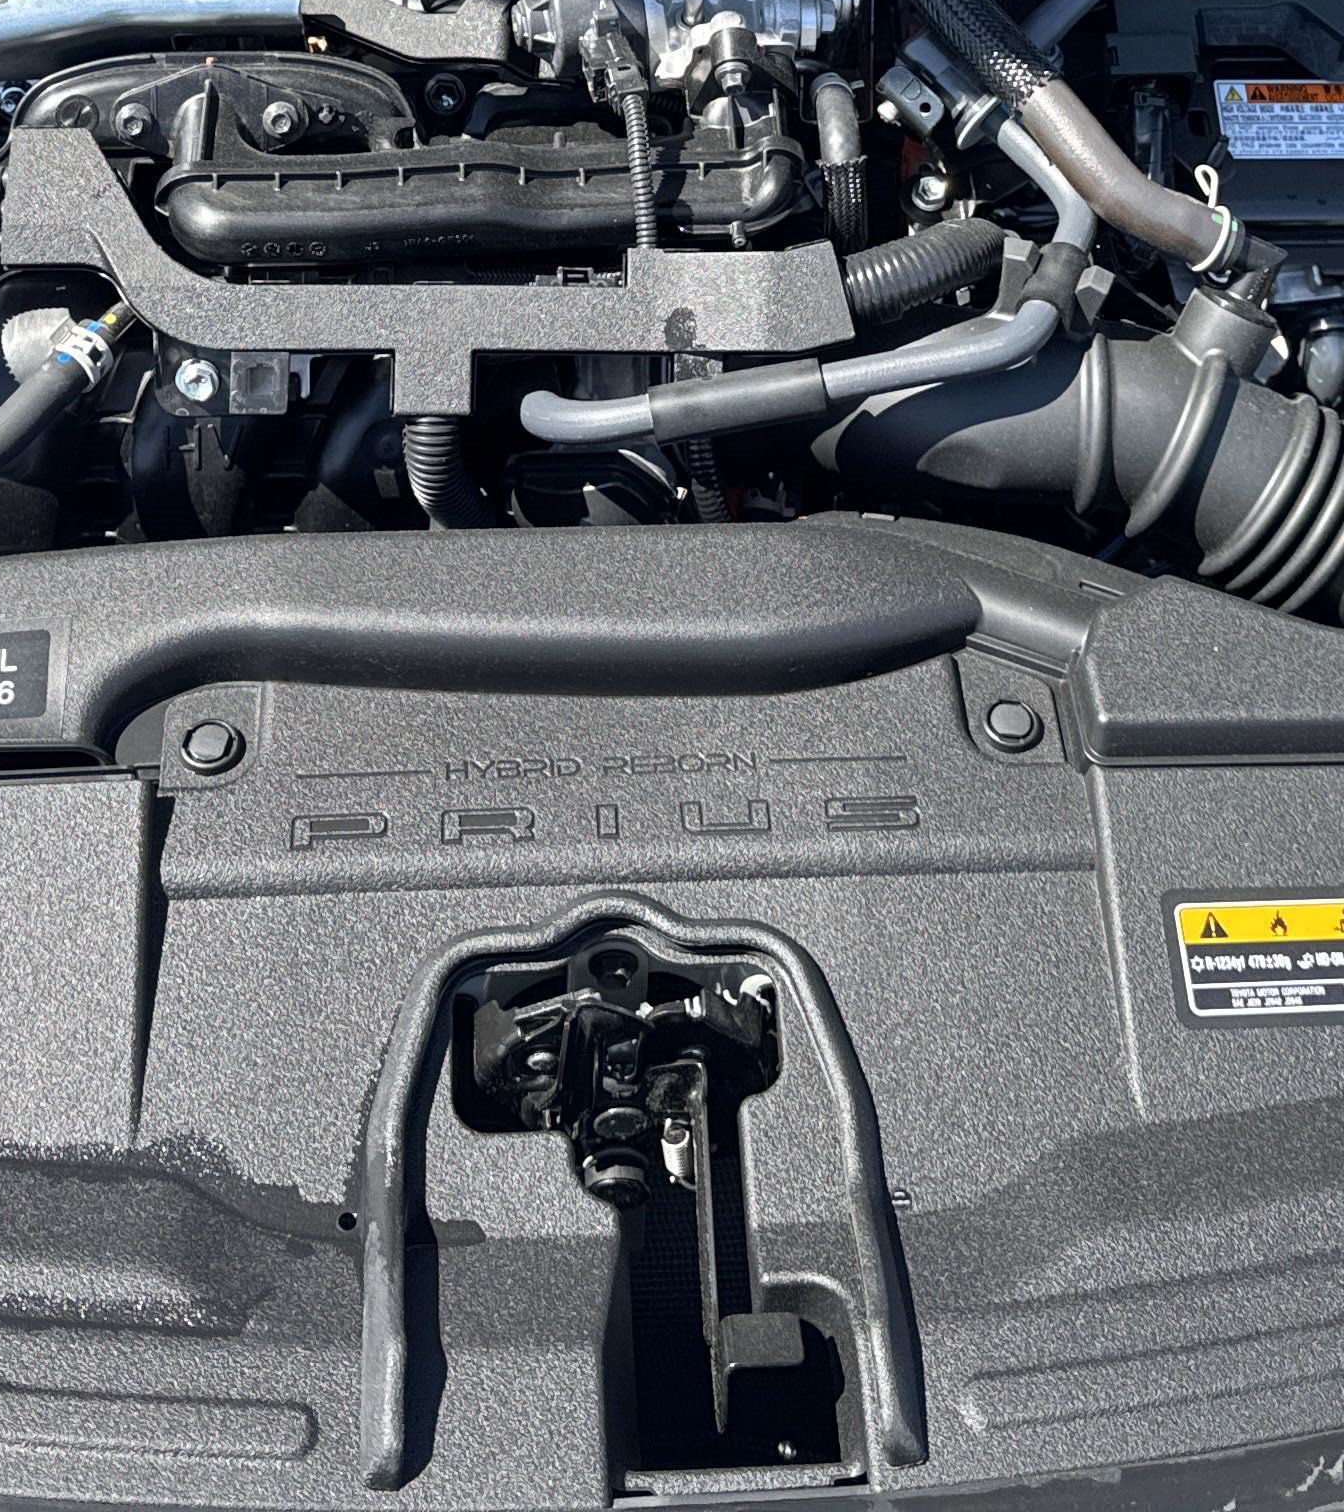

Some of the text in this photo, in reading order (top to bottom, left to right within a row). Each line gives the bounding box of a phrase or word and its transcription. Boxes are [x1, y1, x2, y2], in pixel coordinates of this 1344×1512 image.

[445, 751, 758, 781] HYBRID REBORN
[290, 796, 920, 850] PRIUS
[1230, 986, 1326, 998] TOYOTA MOTOR CORPORATION
